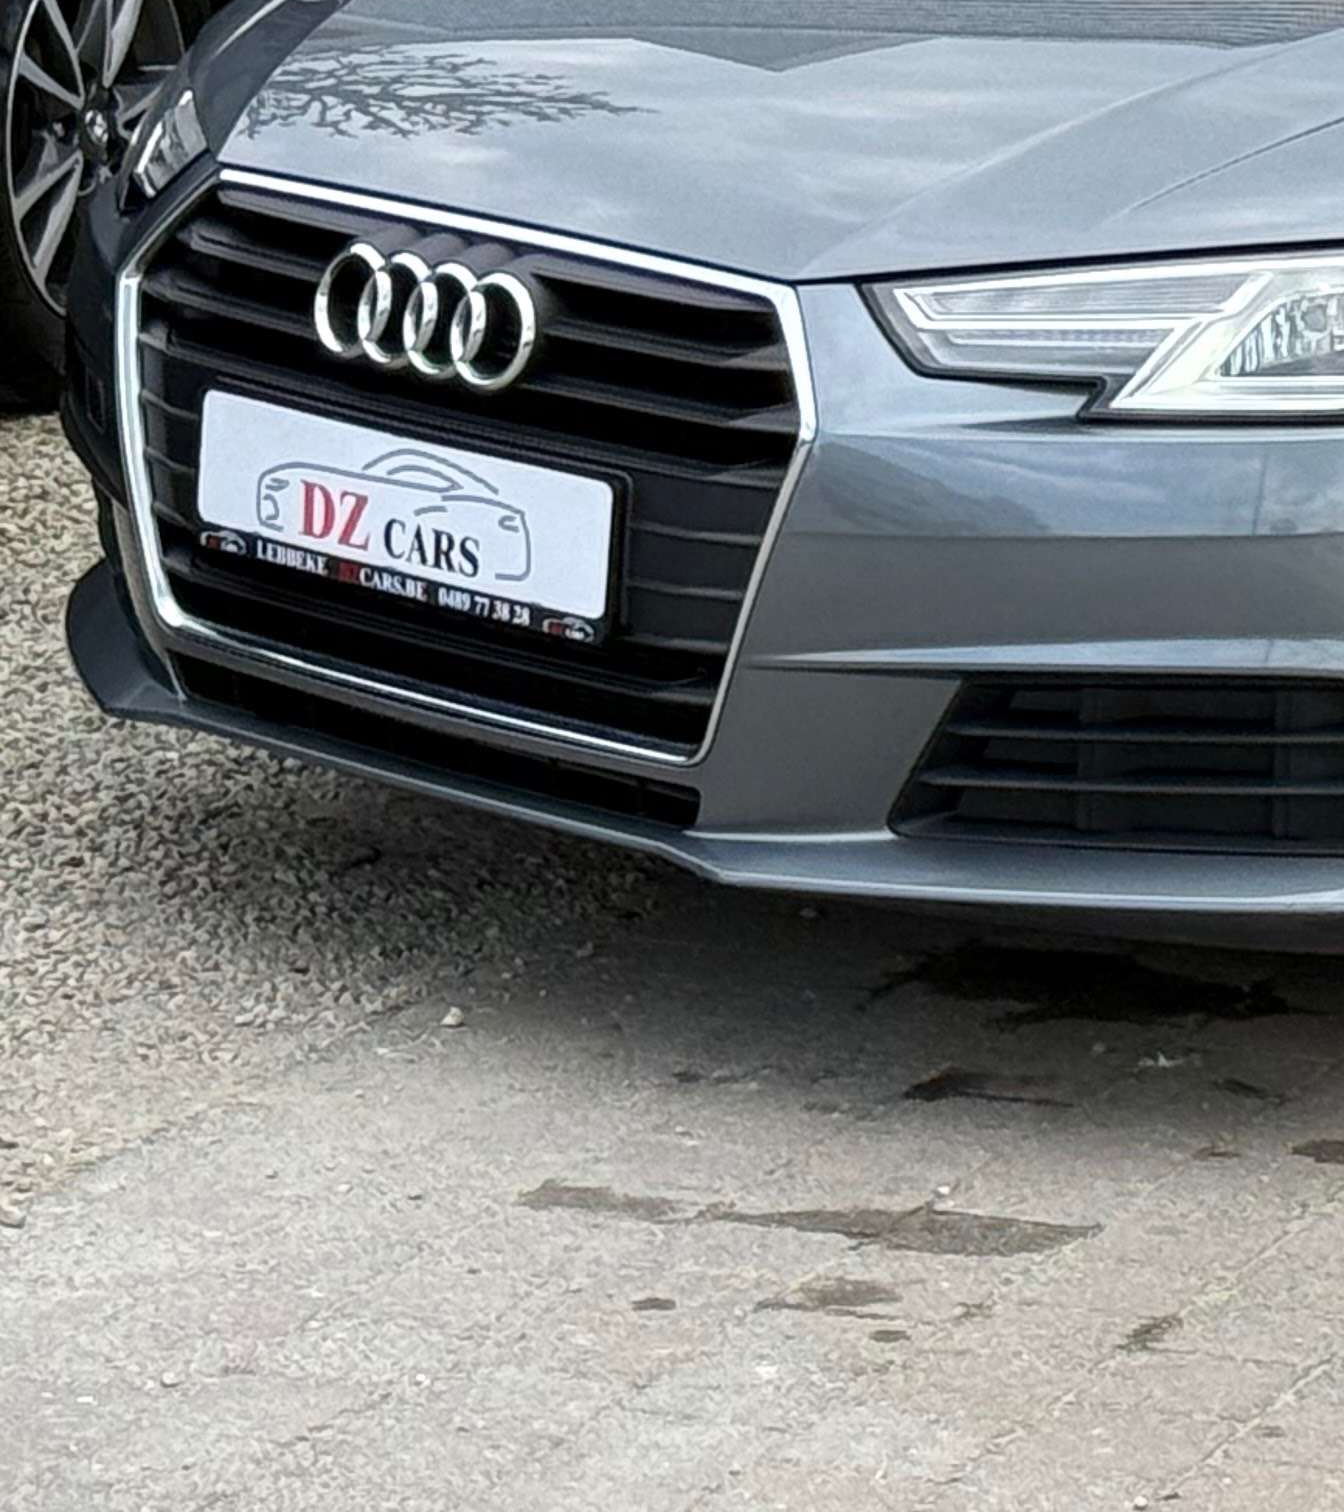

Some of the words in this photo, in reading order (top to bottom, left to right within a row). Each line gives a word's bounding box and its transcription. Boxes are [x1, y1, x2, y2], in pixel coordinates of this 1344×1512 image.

[256, 539, 329, 575] LEBBEKE
[299, 480, 370, 552] DZ
[383, 518, 480, 578] CARS
